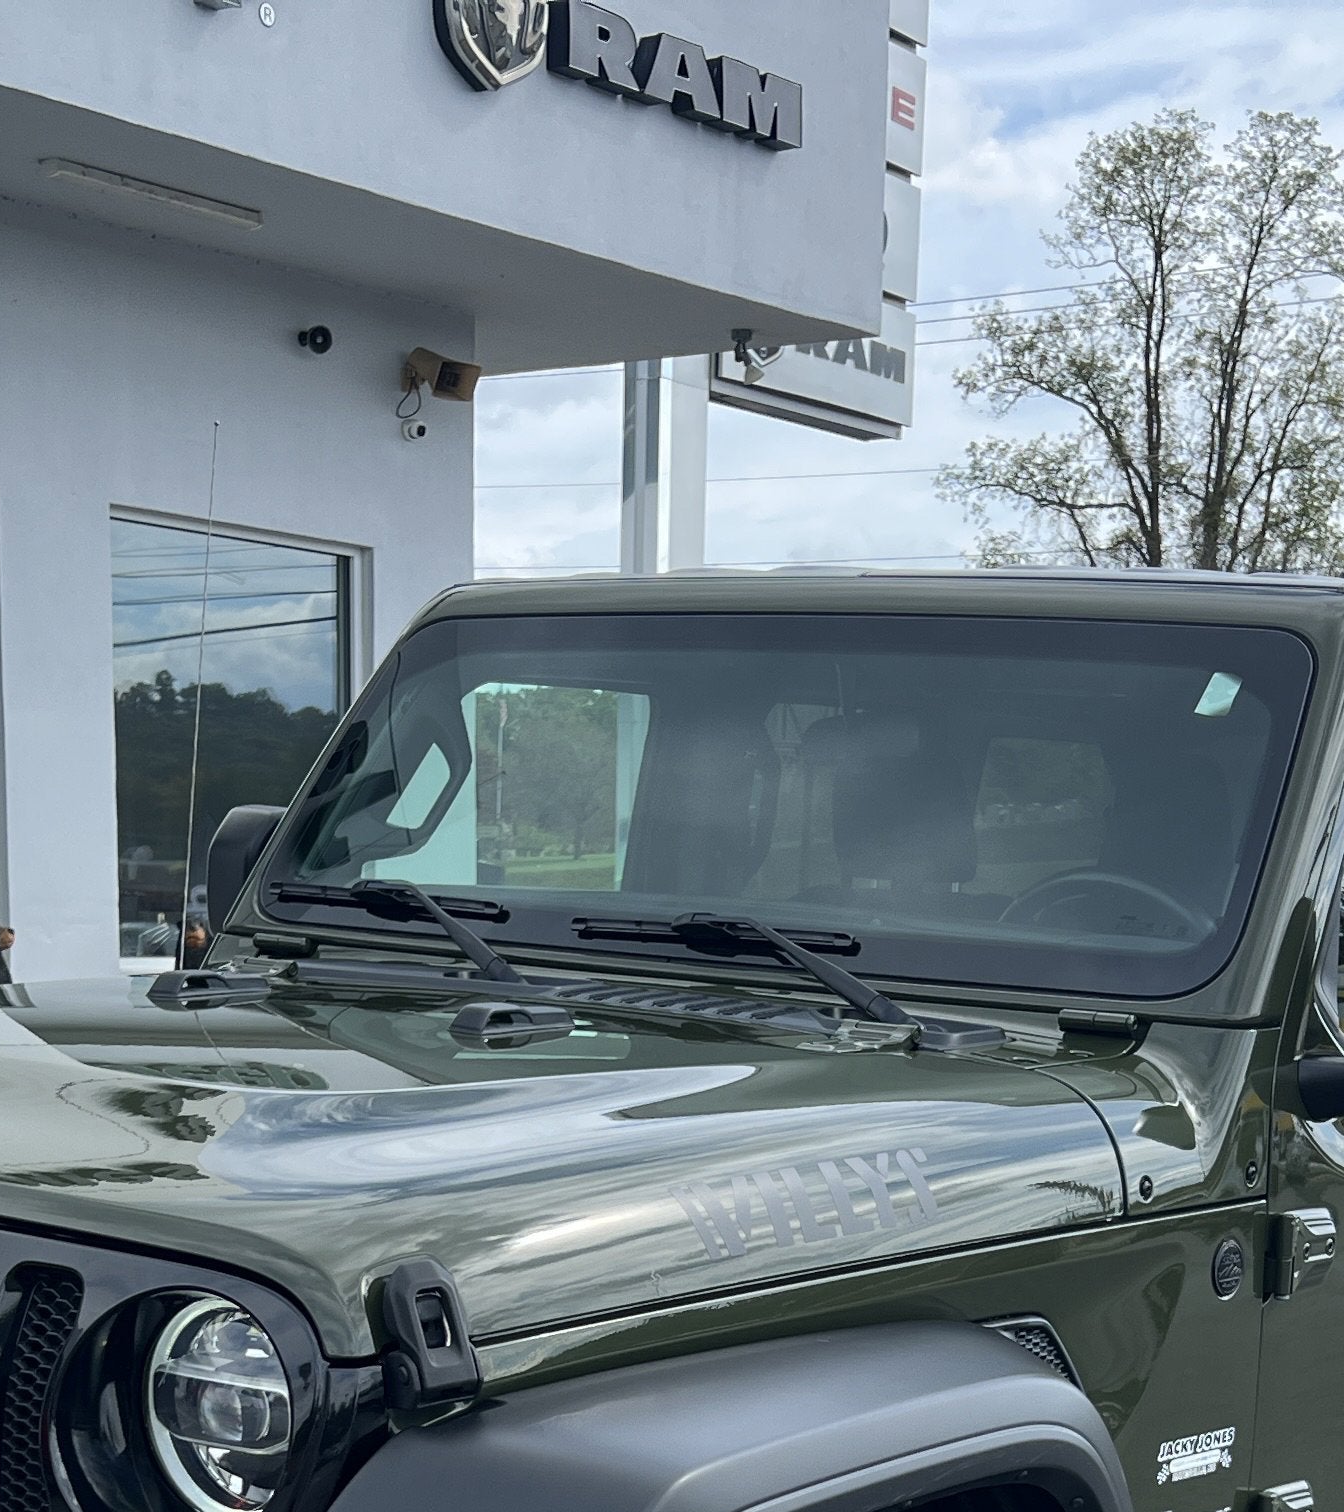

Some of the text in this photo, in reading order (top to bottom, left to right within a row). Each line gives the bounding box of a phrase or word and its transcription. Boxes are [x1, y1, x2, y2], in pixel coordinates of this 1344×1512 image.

[547, 0, 803, 151] RAM
[667, 1147, 938, 1261] WILLYS
[1159, 1437, 1197, 1460] JACKY
[1197, 1429, 1234, 1452] JONES
